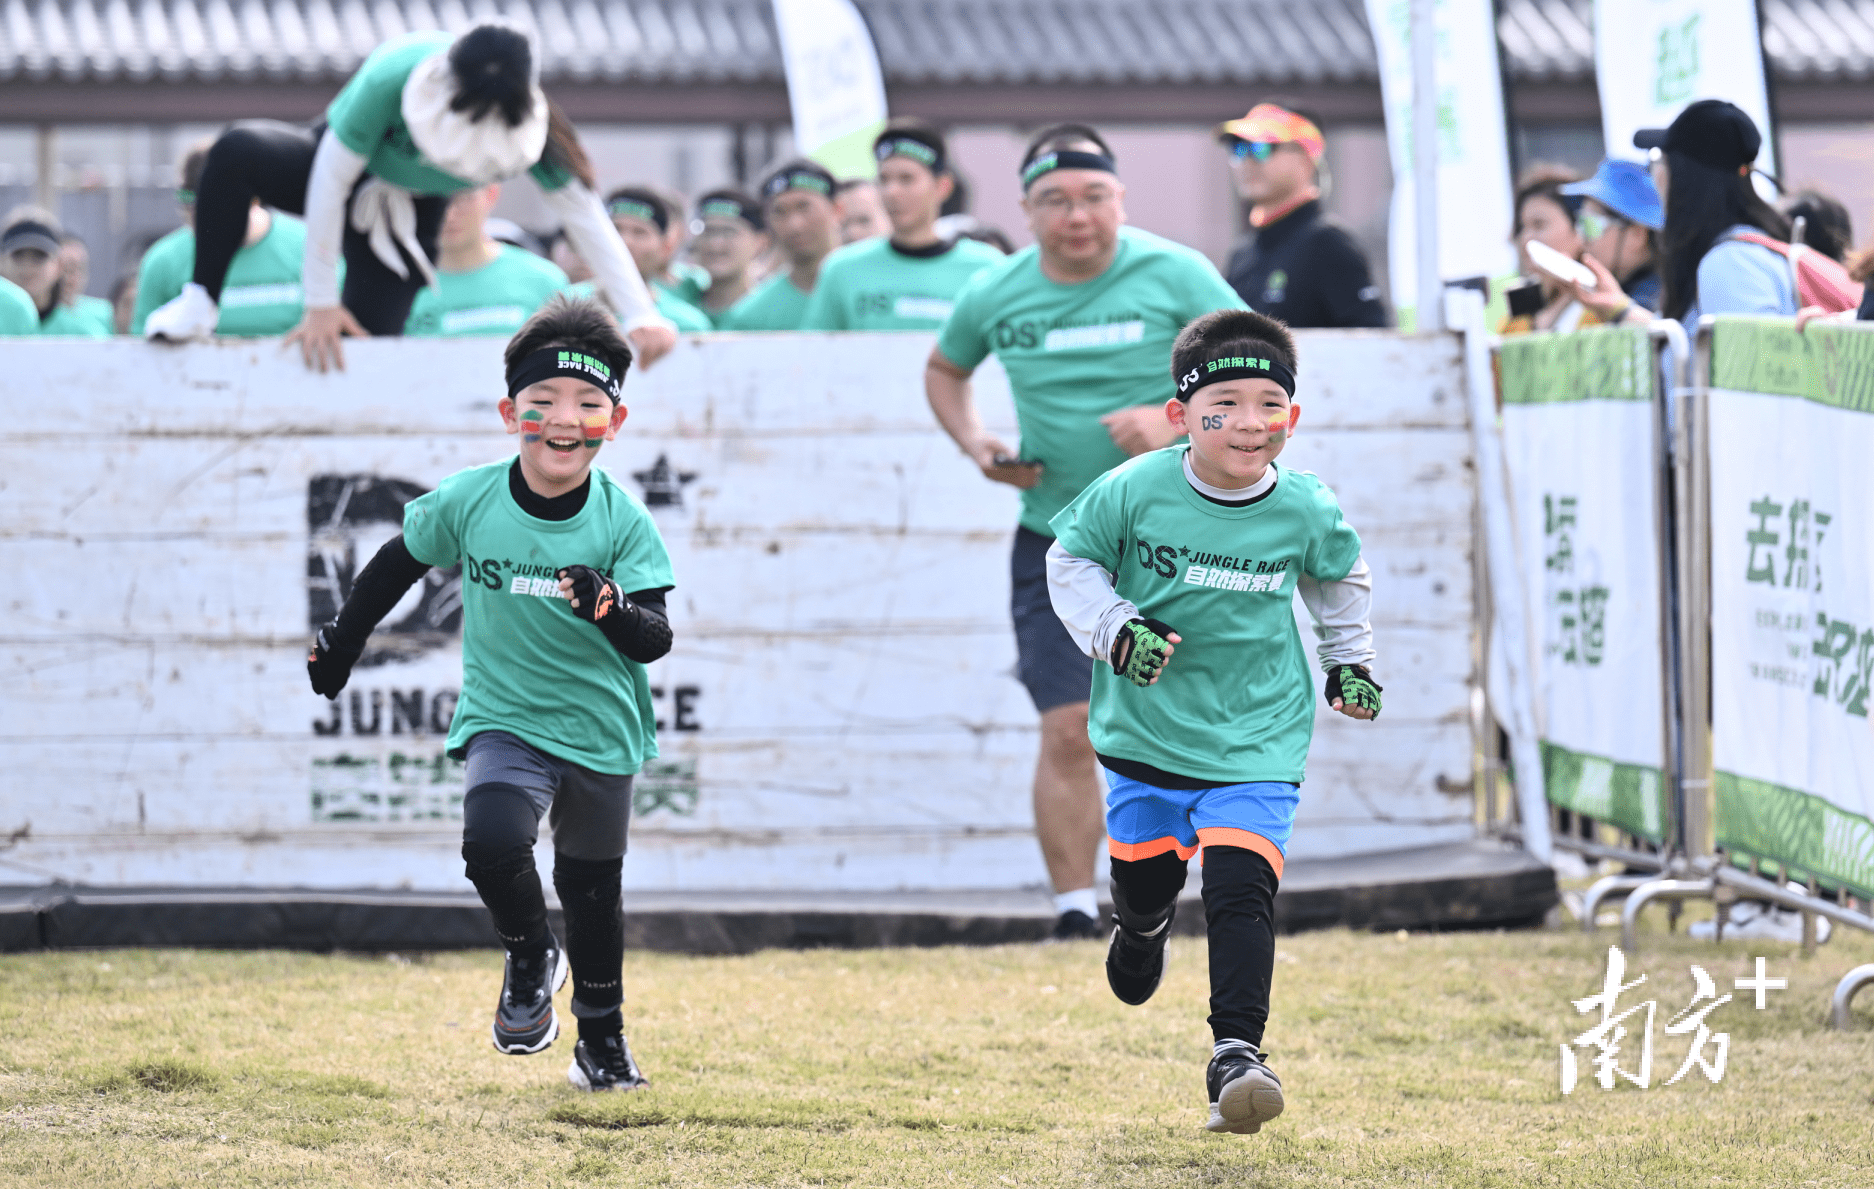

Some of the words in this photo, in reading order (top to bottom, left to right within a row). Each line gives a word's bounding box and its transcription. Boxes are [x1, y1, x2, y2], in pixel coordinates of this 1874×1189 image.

[558, 360, 582, 371] RACE
[1201, 414, 1224, 431] DS
[467, 553, 502, 590] DS
[1136, 537, 1178, 579] DS
[1188, 551, 1252, 571] JUNGLE
[1256, 559, 1290, 573] RACE
[312, 689, 460, 735] JUNG
